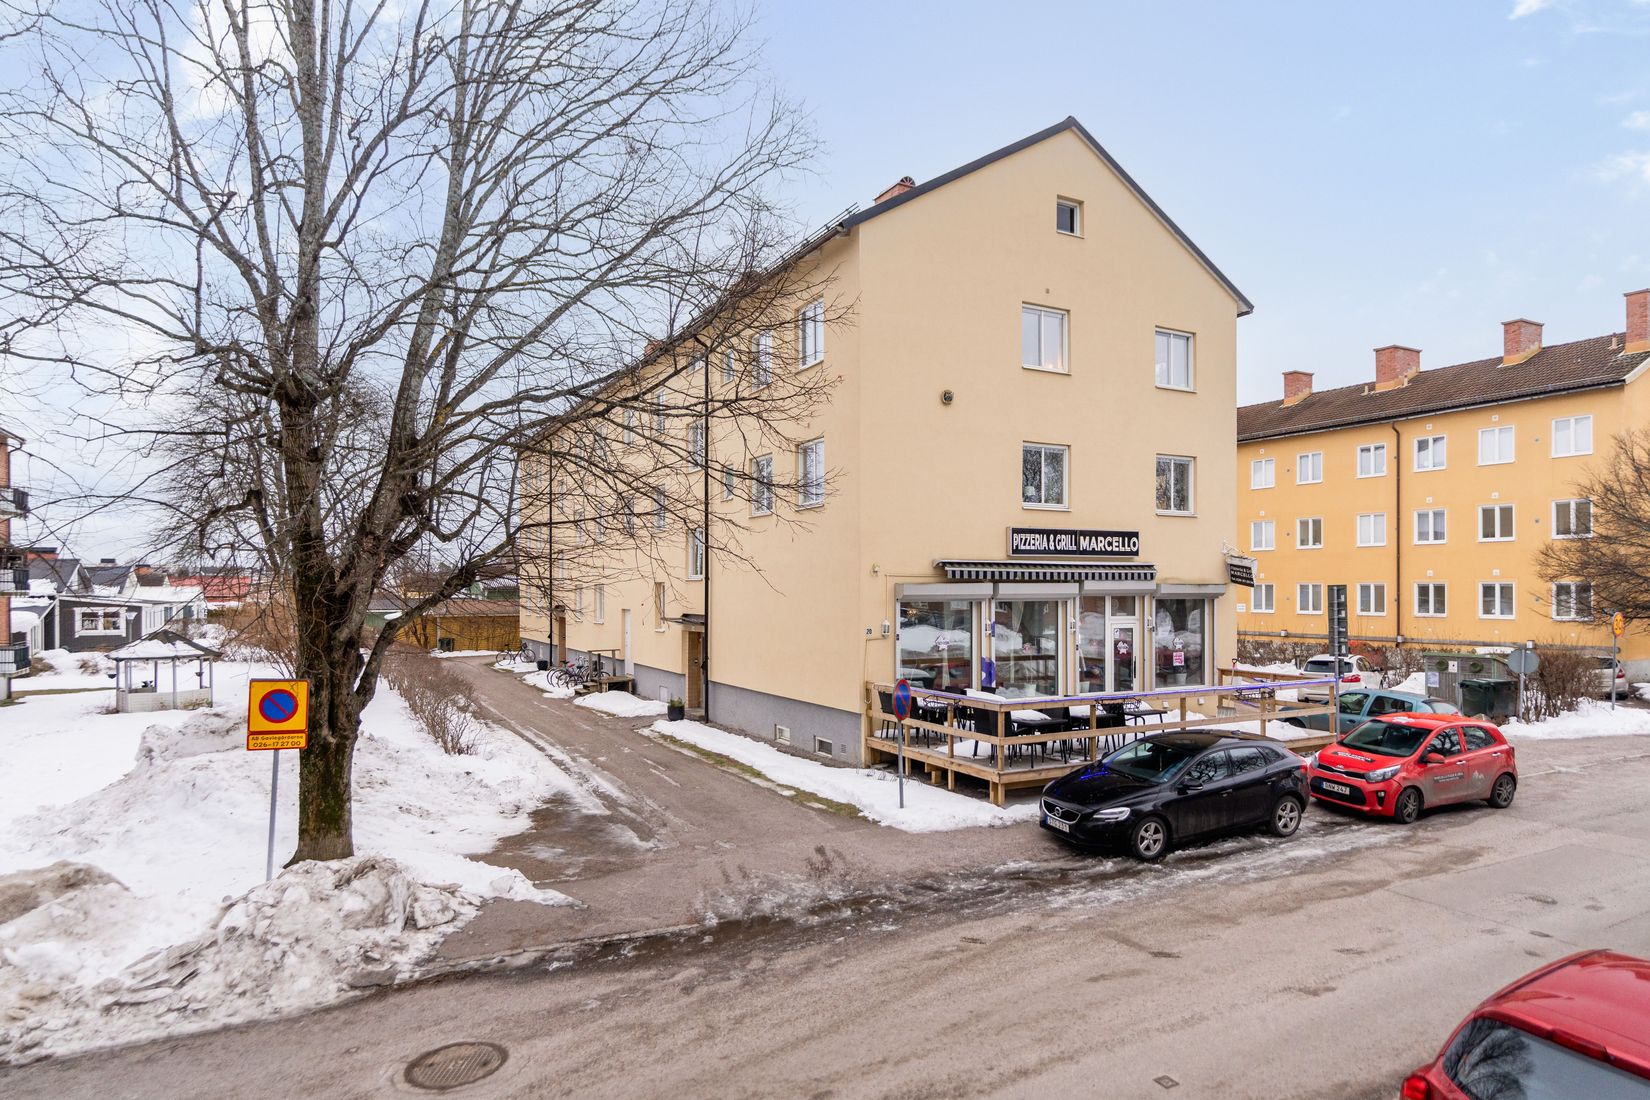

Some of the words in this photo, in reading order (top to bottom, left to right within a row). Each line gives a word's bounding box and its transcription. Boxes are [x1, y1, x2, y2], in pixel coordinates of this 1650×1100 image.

[1013, 533, 1048, 550] PIZZERIA
[1048, 534, 1055, 550] &
[1055, 534, 1077, 551] GRILL
[1079, 536, 1139, 552] MARCELLO
